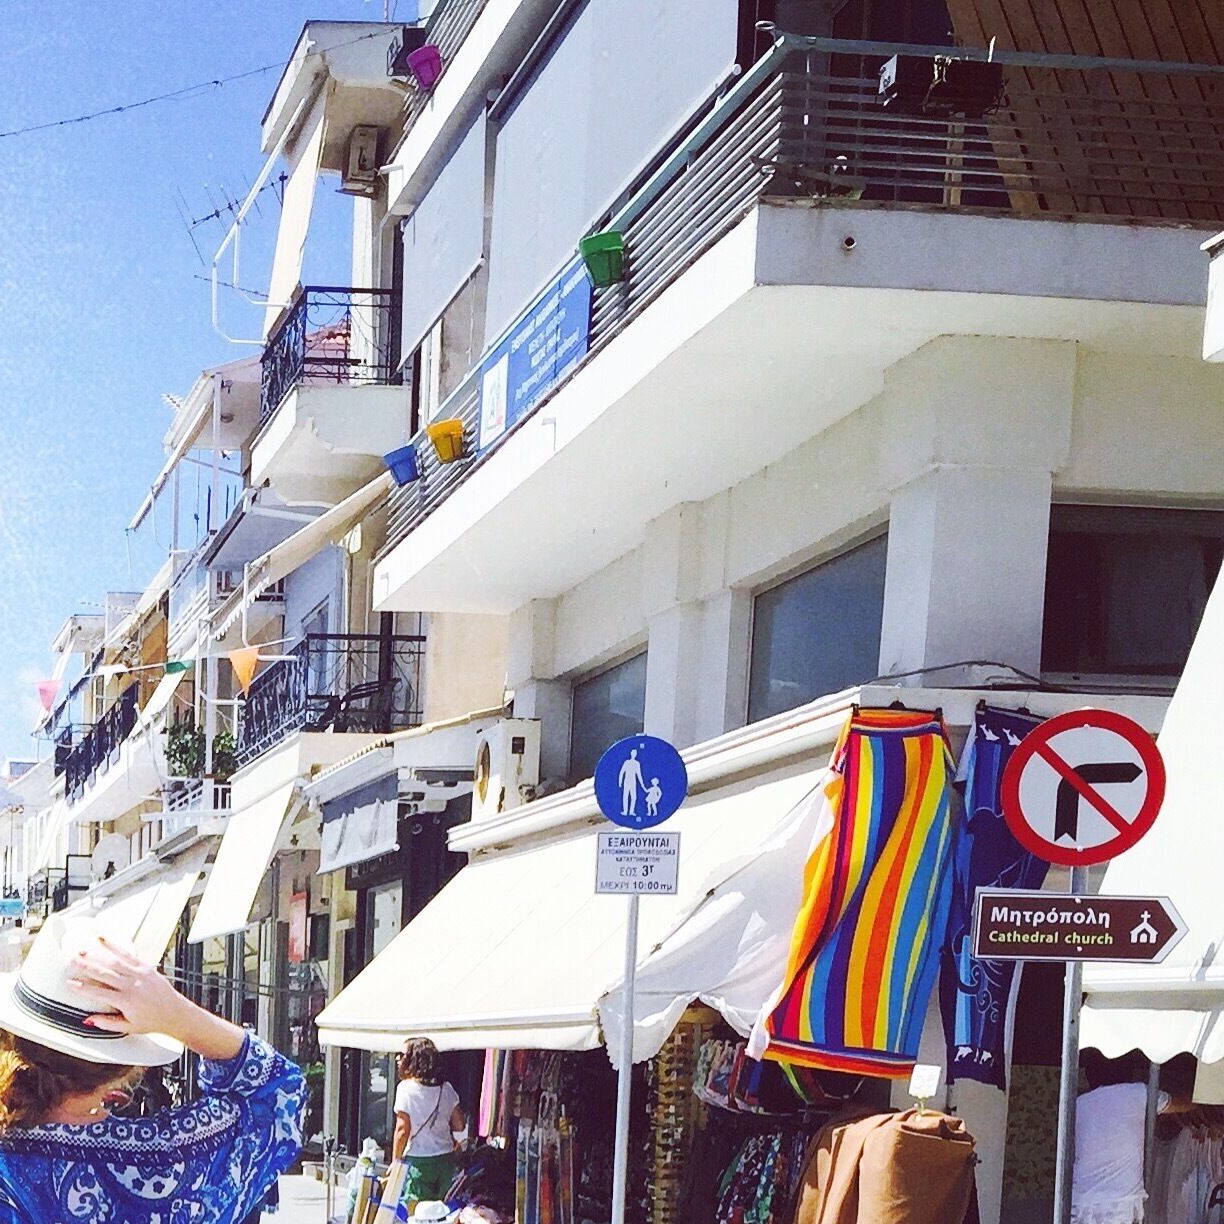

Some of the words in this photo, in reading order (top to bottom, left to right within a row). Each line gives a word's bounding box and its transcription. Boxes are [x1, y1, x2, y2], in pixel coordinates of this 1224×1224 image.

[607, 837, 670, 848] ΕΞΑΙΡΟΥΝΤΑΙ
[990, 906, 1111, 929] Μητρόπολη
[989, 931, 1059, 944] Cathedral
[1064, 931, 1114, 945] church
